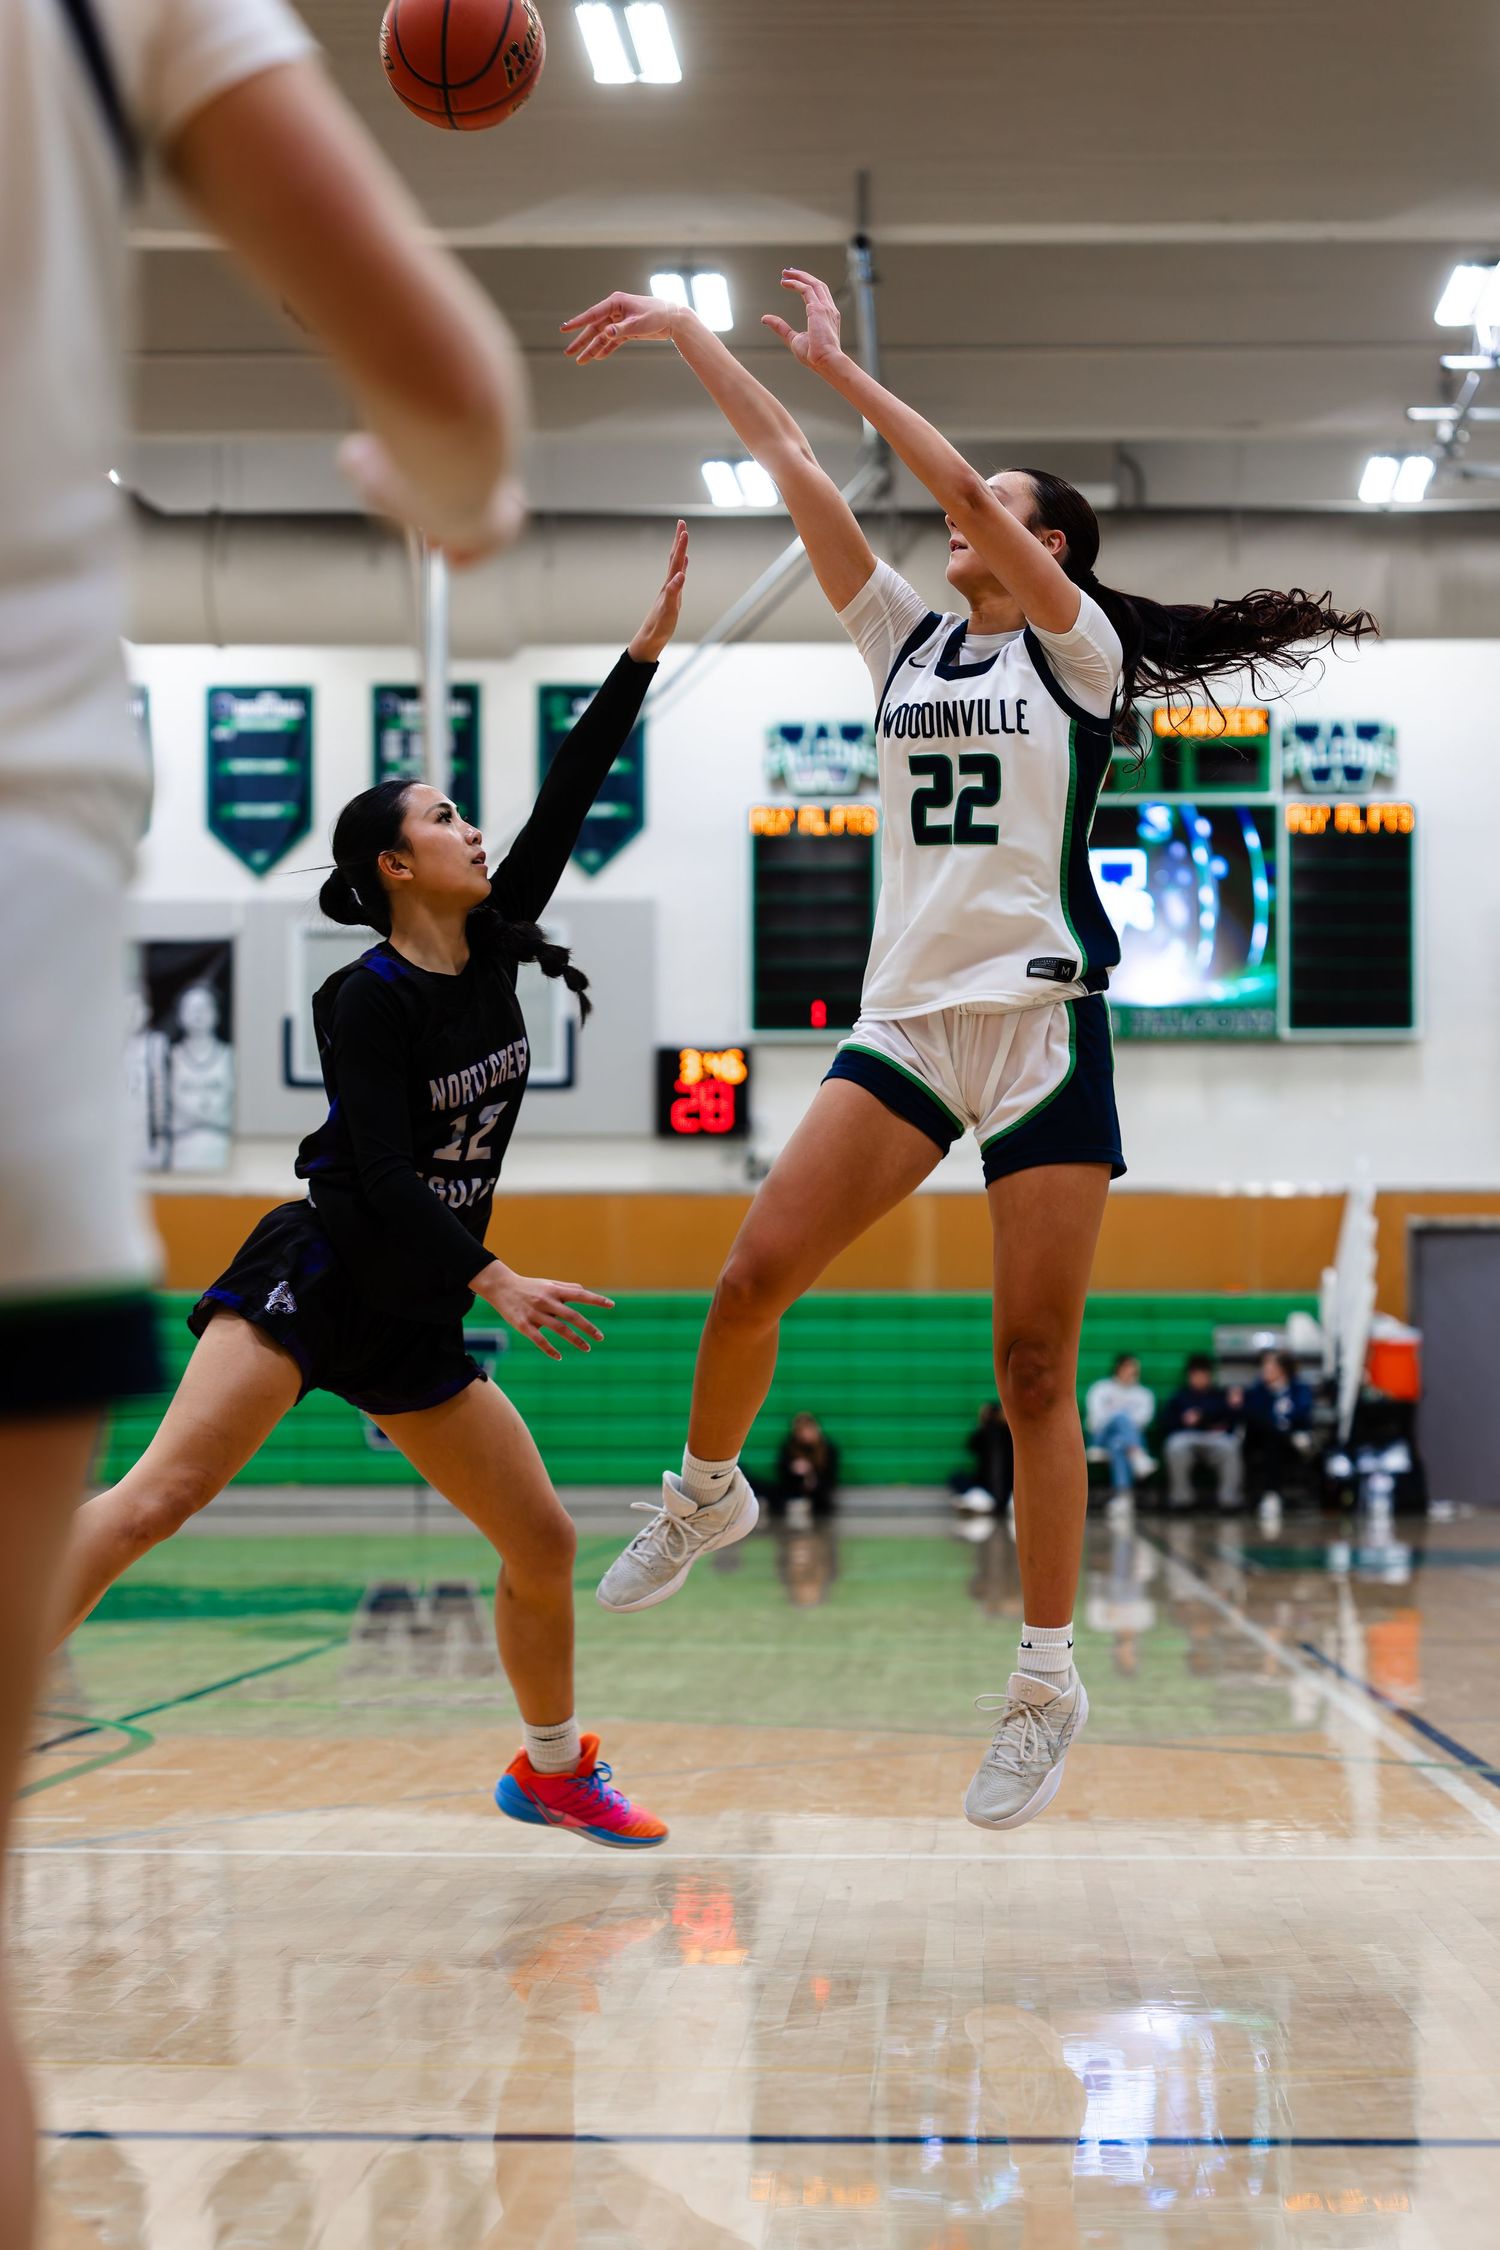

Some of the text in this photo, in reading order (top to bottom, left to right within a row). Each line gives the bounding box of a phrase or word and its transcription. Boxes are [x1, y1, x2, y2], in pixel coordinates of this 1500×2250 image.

[883, 699, 1029, 739] WOODINVILLE
[908, 753, 1001, 846] 22
[1061, 966, 1071, 976] M
[433, 1101, 508, 1161] 12
